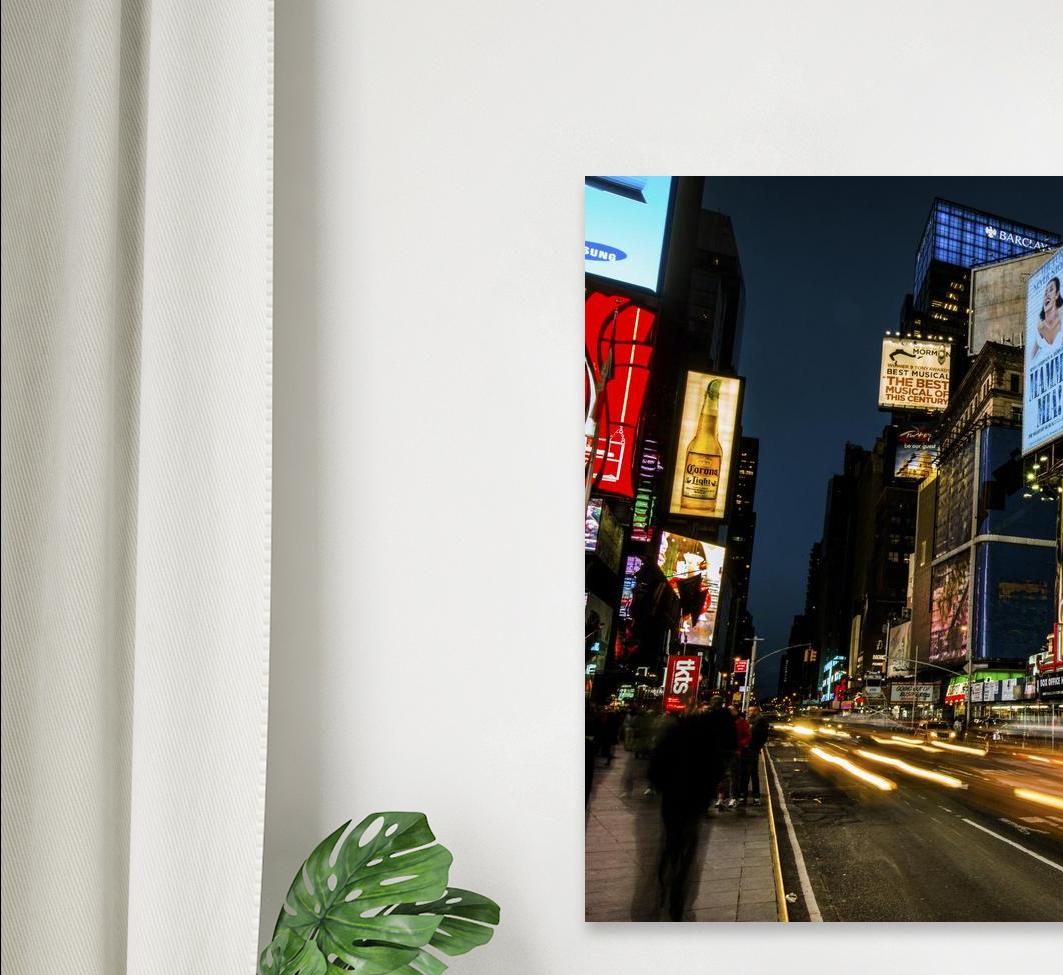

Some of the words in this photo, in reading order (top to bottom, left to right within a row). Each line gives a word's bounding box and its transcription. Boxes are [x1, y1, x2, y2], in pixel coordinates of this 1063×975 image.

[886, 368, 908, 376] BEST
[911, 370, 950, 380] MUSICAL
[916, 378, 949, 390] BEST
[885, 385, 933, 397] MUSICAL
[935, 389, 949, 398] OF
[886, 393, 906, 402] THIS
[907, 395, 948, 405] CENTURY
[672, 658, 696, 695] tkts
[1040, 679, 1048, 687] BOX
[1048, 676, 1060, 686] OFFICE
